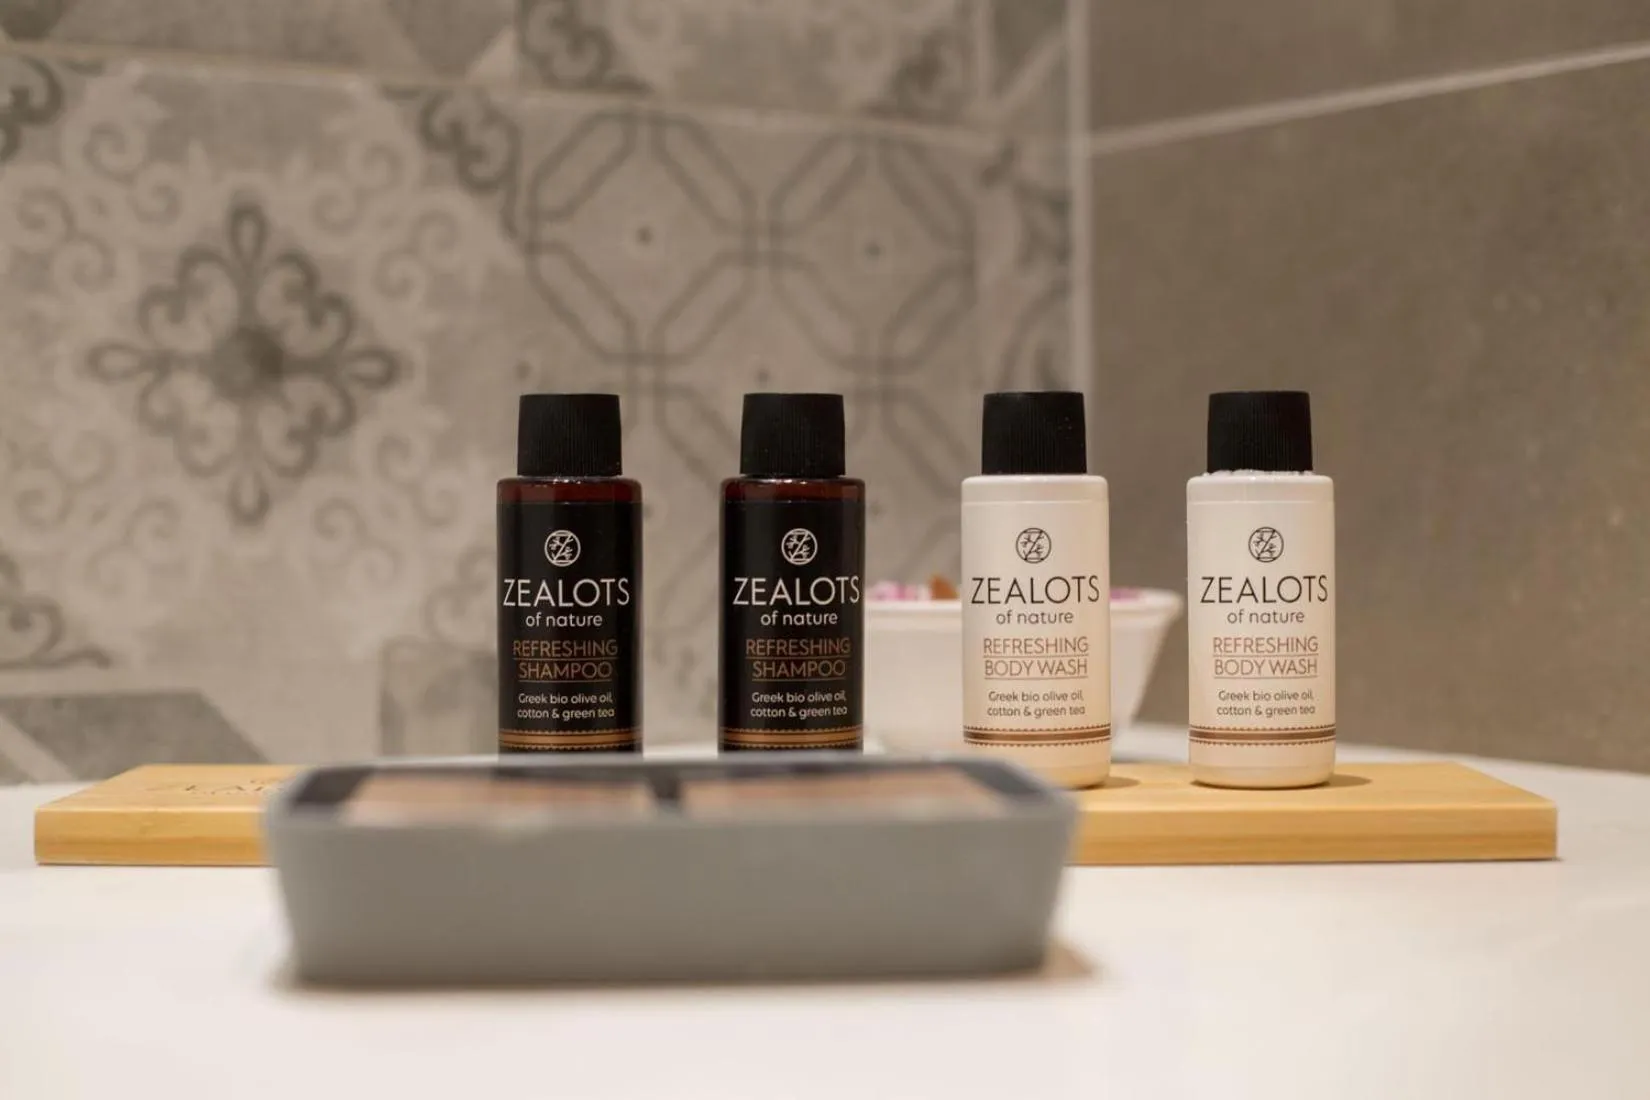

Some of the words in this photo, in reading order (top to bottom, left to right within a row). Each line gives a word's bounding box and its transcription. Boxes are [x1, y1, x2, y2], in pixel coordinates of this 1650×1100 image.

[502, 578, 630, 607] ZEALOTS
[732, 575, 860, 606] ZEALOTS
[971, 575, 1100, 605] ZEALOTS
[1200, 574, 1328, 603] ZEALOTS
[526, 612, 542, 627] of
[546, 614, 603, 627] nature
[760, 611, 778, 626] of
[782, 612, 838, 626] nature
[996, 610, 1013, 625] of
[1017, 611, 1074, 624] nature
[1227, 609, 1244, 624] of
[1250, 610, 1305, 624] nature
[513, 639, 618, 658] REFRESHING
[746, 637, 850, 656] REFRESHING
[983, 636, 1089, 655] REFRESHING
[1213, 636, 1319, 654] REFRESHING
[519, 662, 613, 679] SHAMPOO
[752, 660, 846, 678] SHAMPOO
[985, 660, 1034, 676] BODY
[1037, 659, 1088, 675] WASH
[1214, 659, 1265, 676] BODY
[1268, 658, 1318, 675] WASH
[519, 693, 548, 704] Greek
[550, 693, 568, 704] bio
[570, 693, 597, 704] olive
[751, 692, 784, 703] Greek
[786, 692, 805, 703] bio
[807, 691, 833, 702] olive
[988, 691, 1018, 702] Greek
[1021, 691, 1040, 702] bio
[1042, 690, 1068, 701] olive
[1218, 690, 1249, 701] Greek
[1253, 690, 1271, 701] bio
[1274, 690, 1299, 701] olive
[517, 708, 549, 719] cotton
[552, 708, 560, 718] &
[562, 708, 595, 721] green
[598, 708, 615, 717] tea
[750, 706, 786, 718] cotton
[788, 707, 796, 717] &
[799, 707, 831, 720] green
[833, 706, 848, 715] tea
[987, 706, 1020, 717] cotton
[1023, 706, 1031, 716] &
[1034, 706, 1066, 719] green
[1069, 705, 1086, 715] tea
[1217, 705, 1251, 715] cotton
[1255, 706, 1262, 715] &
[1266, 706, 1298, 718] green
[1300, 705, 1316, 714] tea
